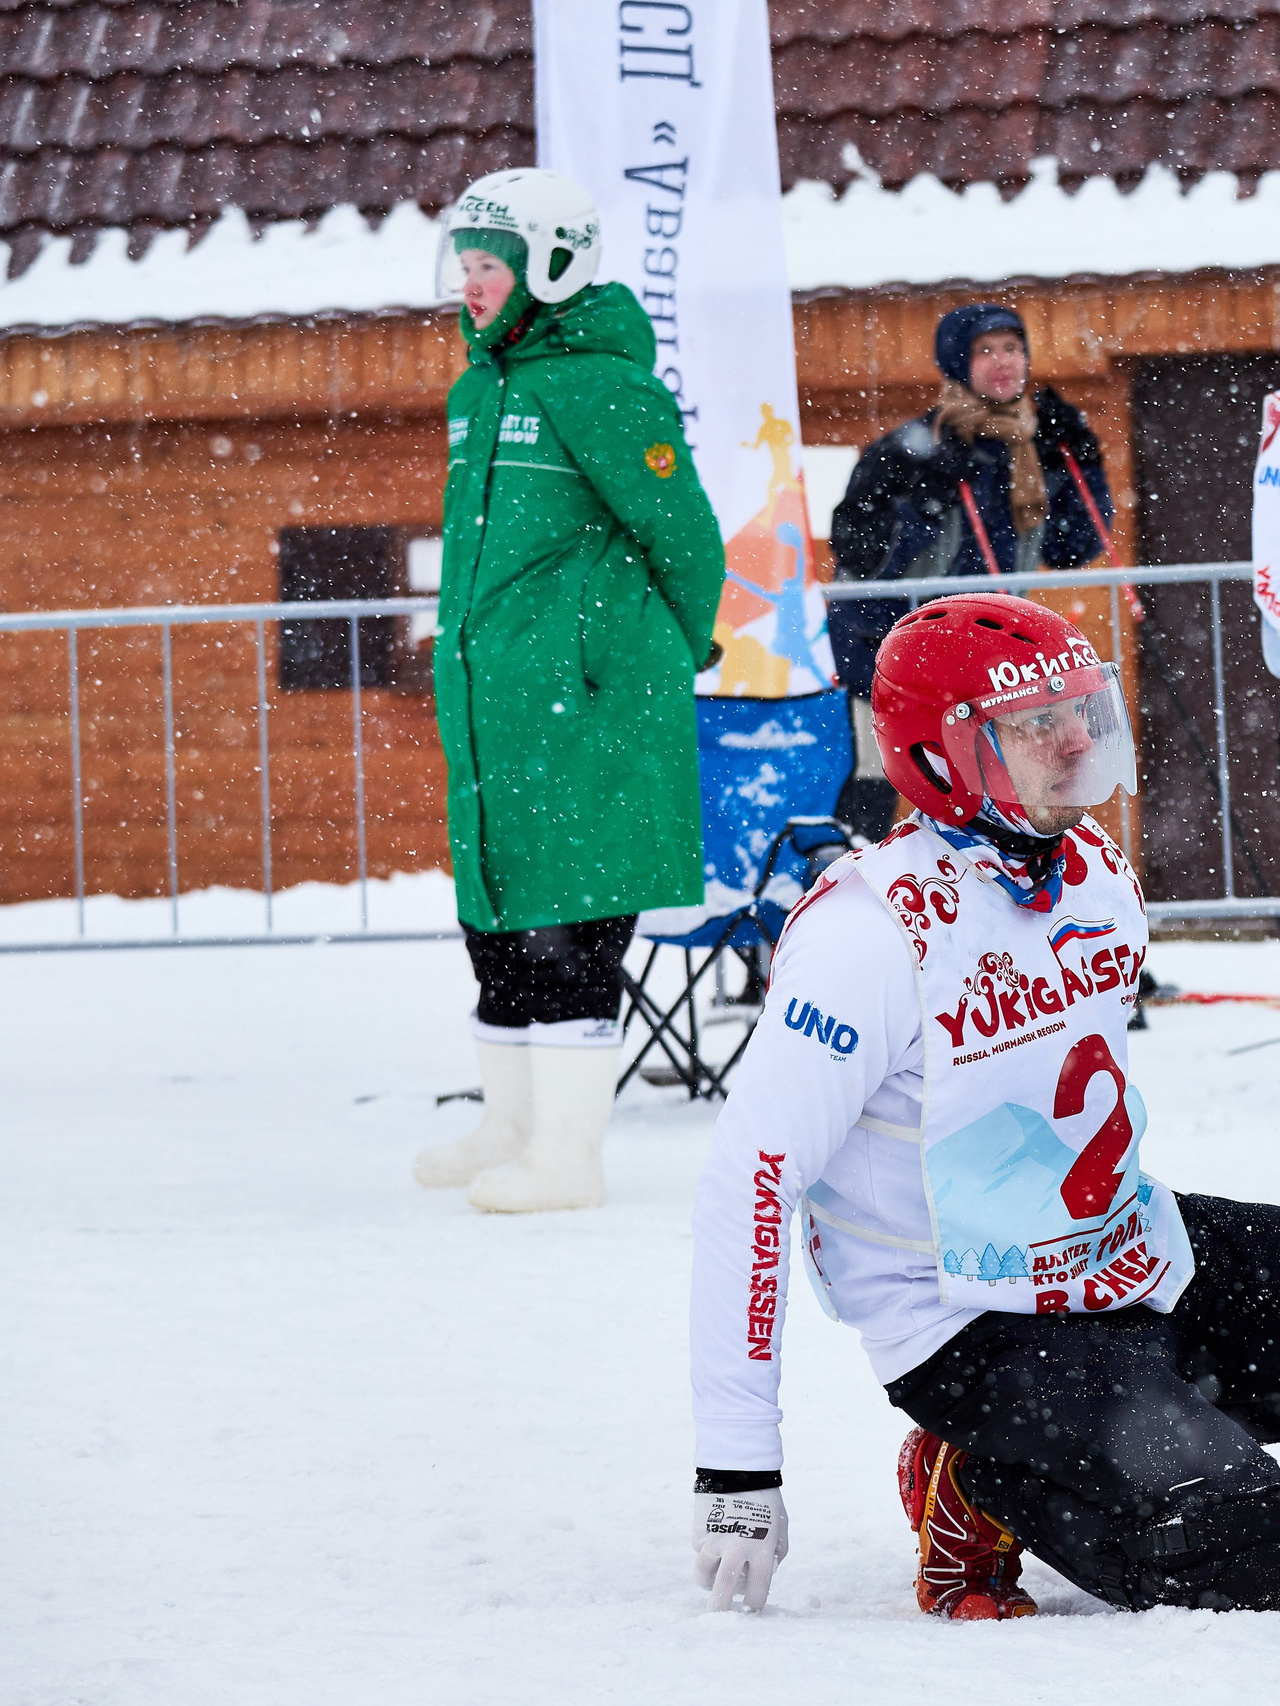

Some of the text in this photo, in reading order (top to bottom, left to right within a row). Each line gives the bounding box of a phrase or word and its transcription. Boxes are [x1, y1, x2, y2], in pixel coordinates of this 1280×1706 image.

[980, 686, 1040, 710] МУРМАНСК
[782, 996, 860, 1055] UNO
[952, 1020, 1067, 1067] RUSSIA, MURMANSK REGION
[829, 1053, 847, 1063] TEAM
[1053, 1033, 1133, 1220] 2
[746, 1146, 787, 1361] YUKIGASSEN
[1096, 1210, 1143, 1262] ТОЛ
[1033, 1271, 1068, 1287] КТО
[1036, 1289, 1071, 1315] В
